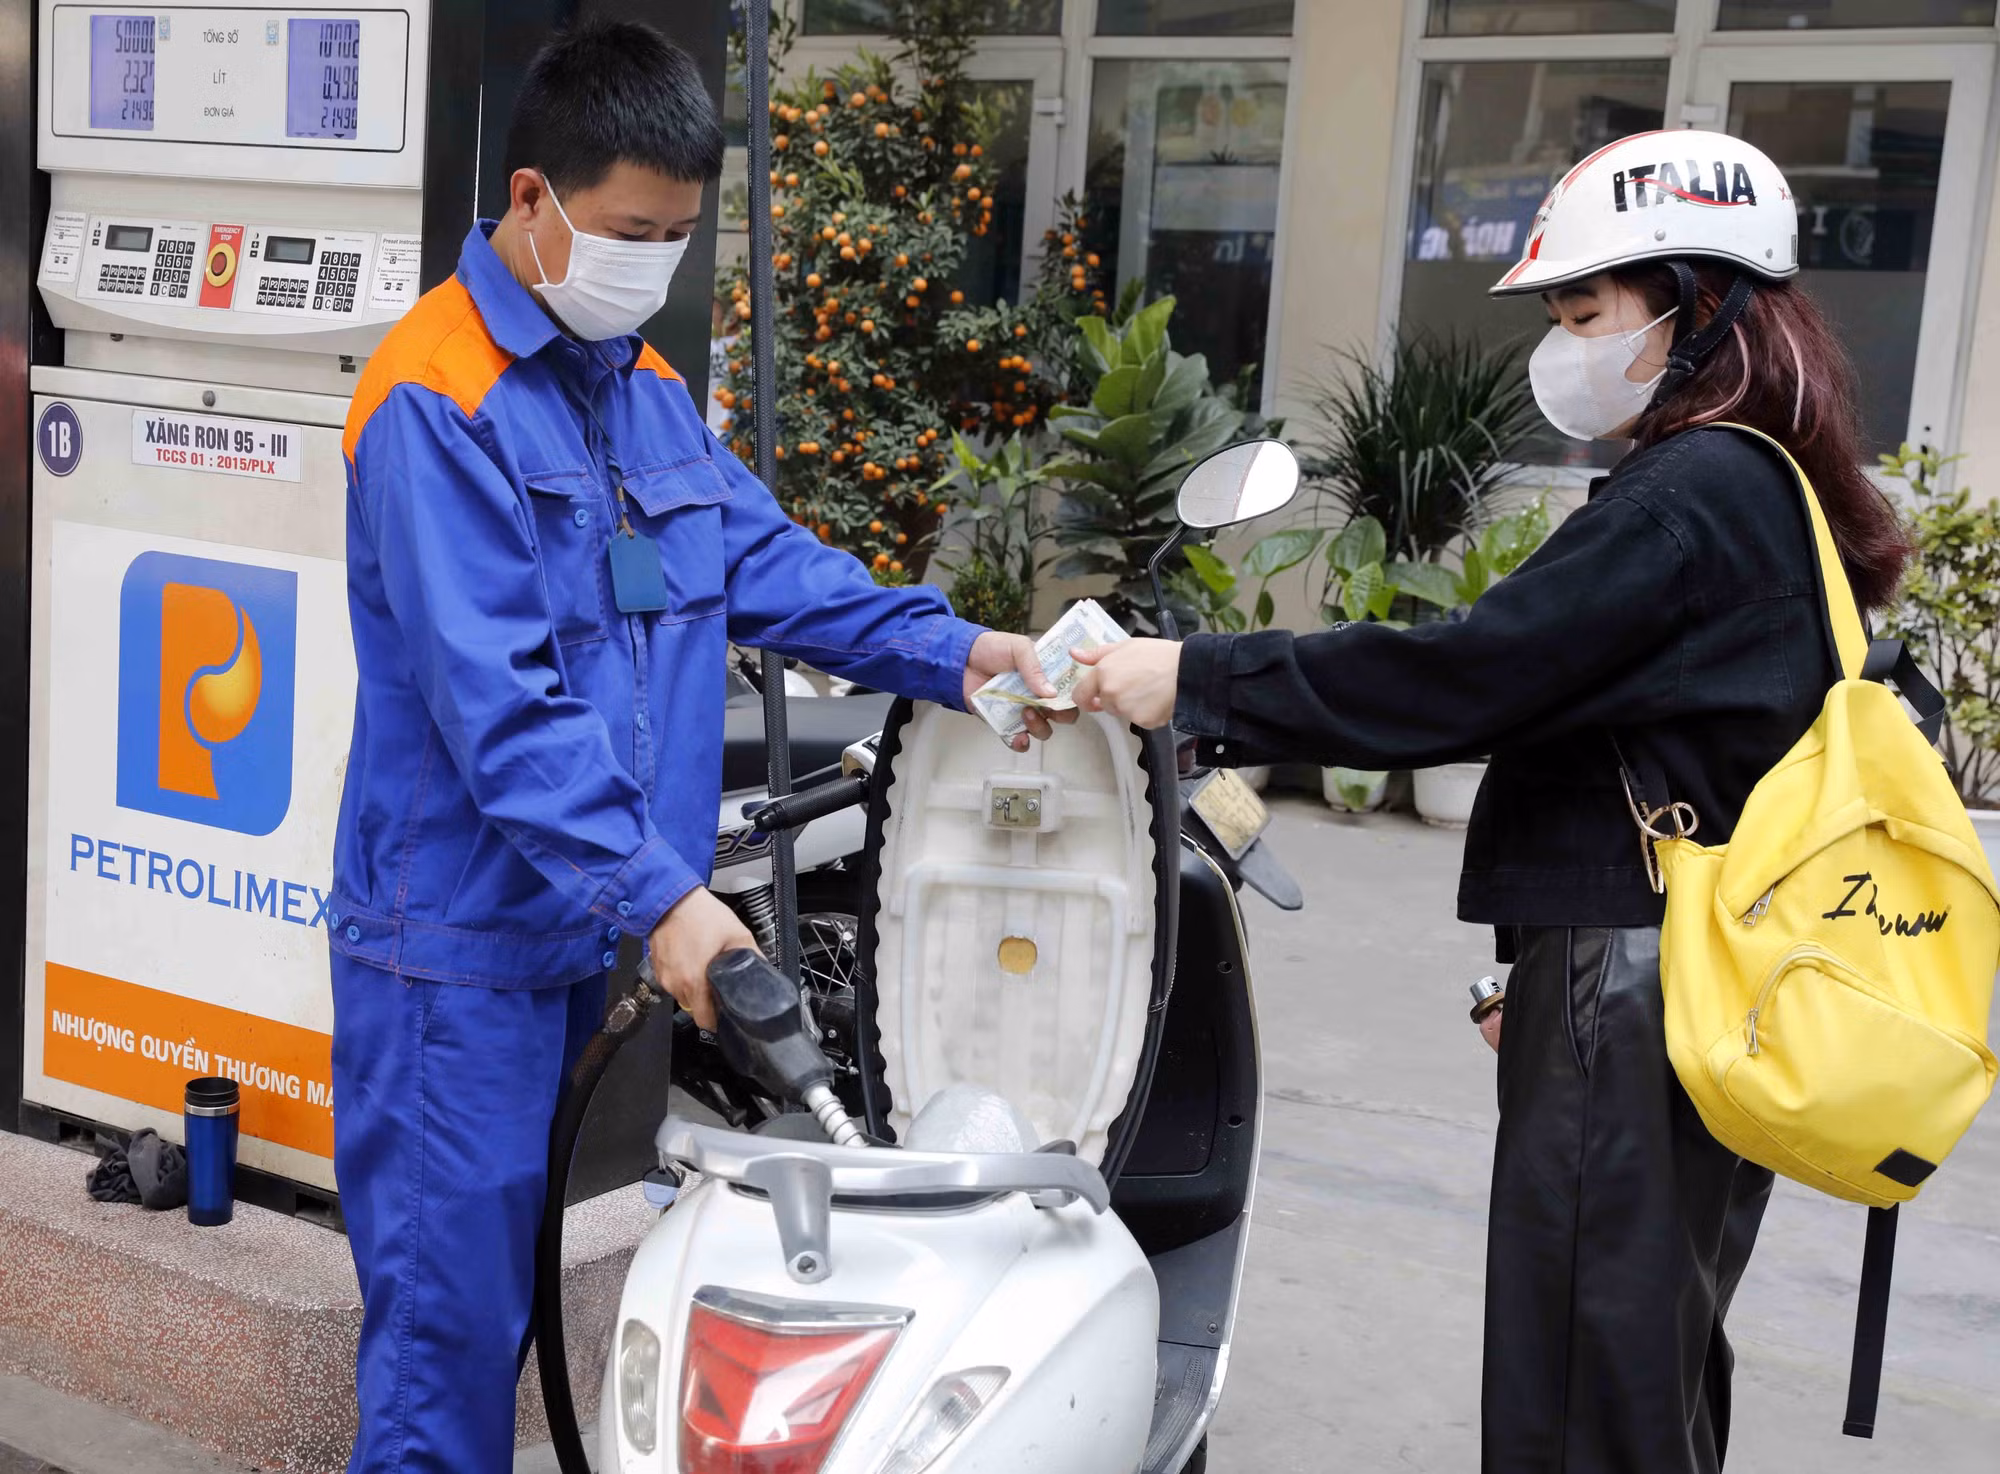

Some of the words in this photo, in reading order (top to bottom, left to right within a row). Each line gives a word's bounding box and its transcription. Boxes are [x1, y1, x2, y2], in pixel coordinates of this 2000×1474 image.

[203, 29, 224, 43] TỔNG
[227, 29, 239, 43] SỐ
[213, 69, 226, 84] LÍT
[204, 106, 220, 117] ĐƠN
[221, 105, 234, 117] GIÁ
[321, 106, 357, 129] 21490
[1613, 159, 1757, 212] ITALIA
[214, 226, 241, 234] EMERGENCY
[323, 253, 329, 262] 7
[333, 254, 338, 264] 8
[343, 255, 349, 264] 9
[321, 268, 326, 278] 4
[330, 269, 336, 279] 5
[340, 270, 346, 280] 6
[260, 279, 267, 287] P1
[270, 280, 278, 288] P2
[280, 281, 287, 289] P3
[290, 282, 297, 290] P4
[300, 282, 307, 291] P5
[318, 283, 322, 293] 1
[327, 284, 333, 294] 2
[337, 285, 343, 295] 3
[258, 294, 265, 302] P6
[268, 295, 275, 303] P7
[278, 296, 285, 304] P8
[287, 297, 295, 305] P9
[315, 298, 320, 308] 0
[325, 299, 331, 309] C
[48, 421, 71, 459] 1B
[145, 416, 190, 448] XĂNG
[195, 425, 229, 451] RON
[234, 429, 254, 454] 95
[271, 433, 288, 458] III
[155, 448, 187, 463] TCCS
[190, 452, 204, 466] 01
[209, 456, 213, 467] :
[217, 456, 275, 475] 2015/PLX
[70, 833, 332, 928] PETROLIMEX
[52, 1010, 135, 1052] NHƯỢNG
[140, 1036, 209, 1073] QUYỀN
[214, 1053, 301, 1099] THƯƠNG
